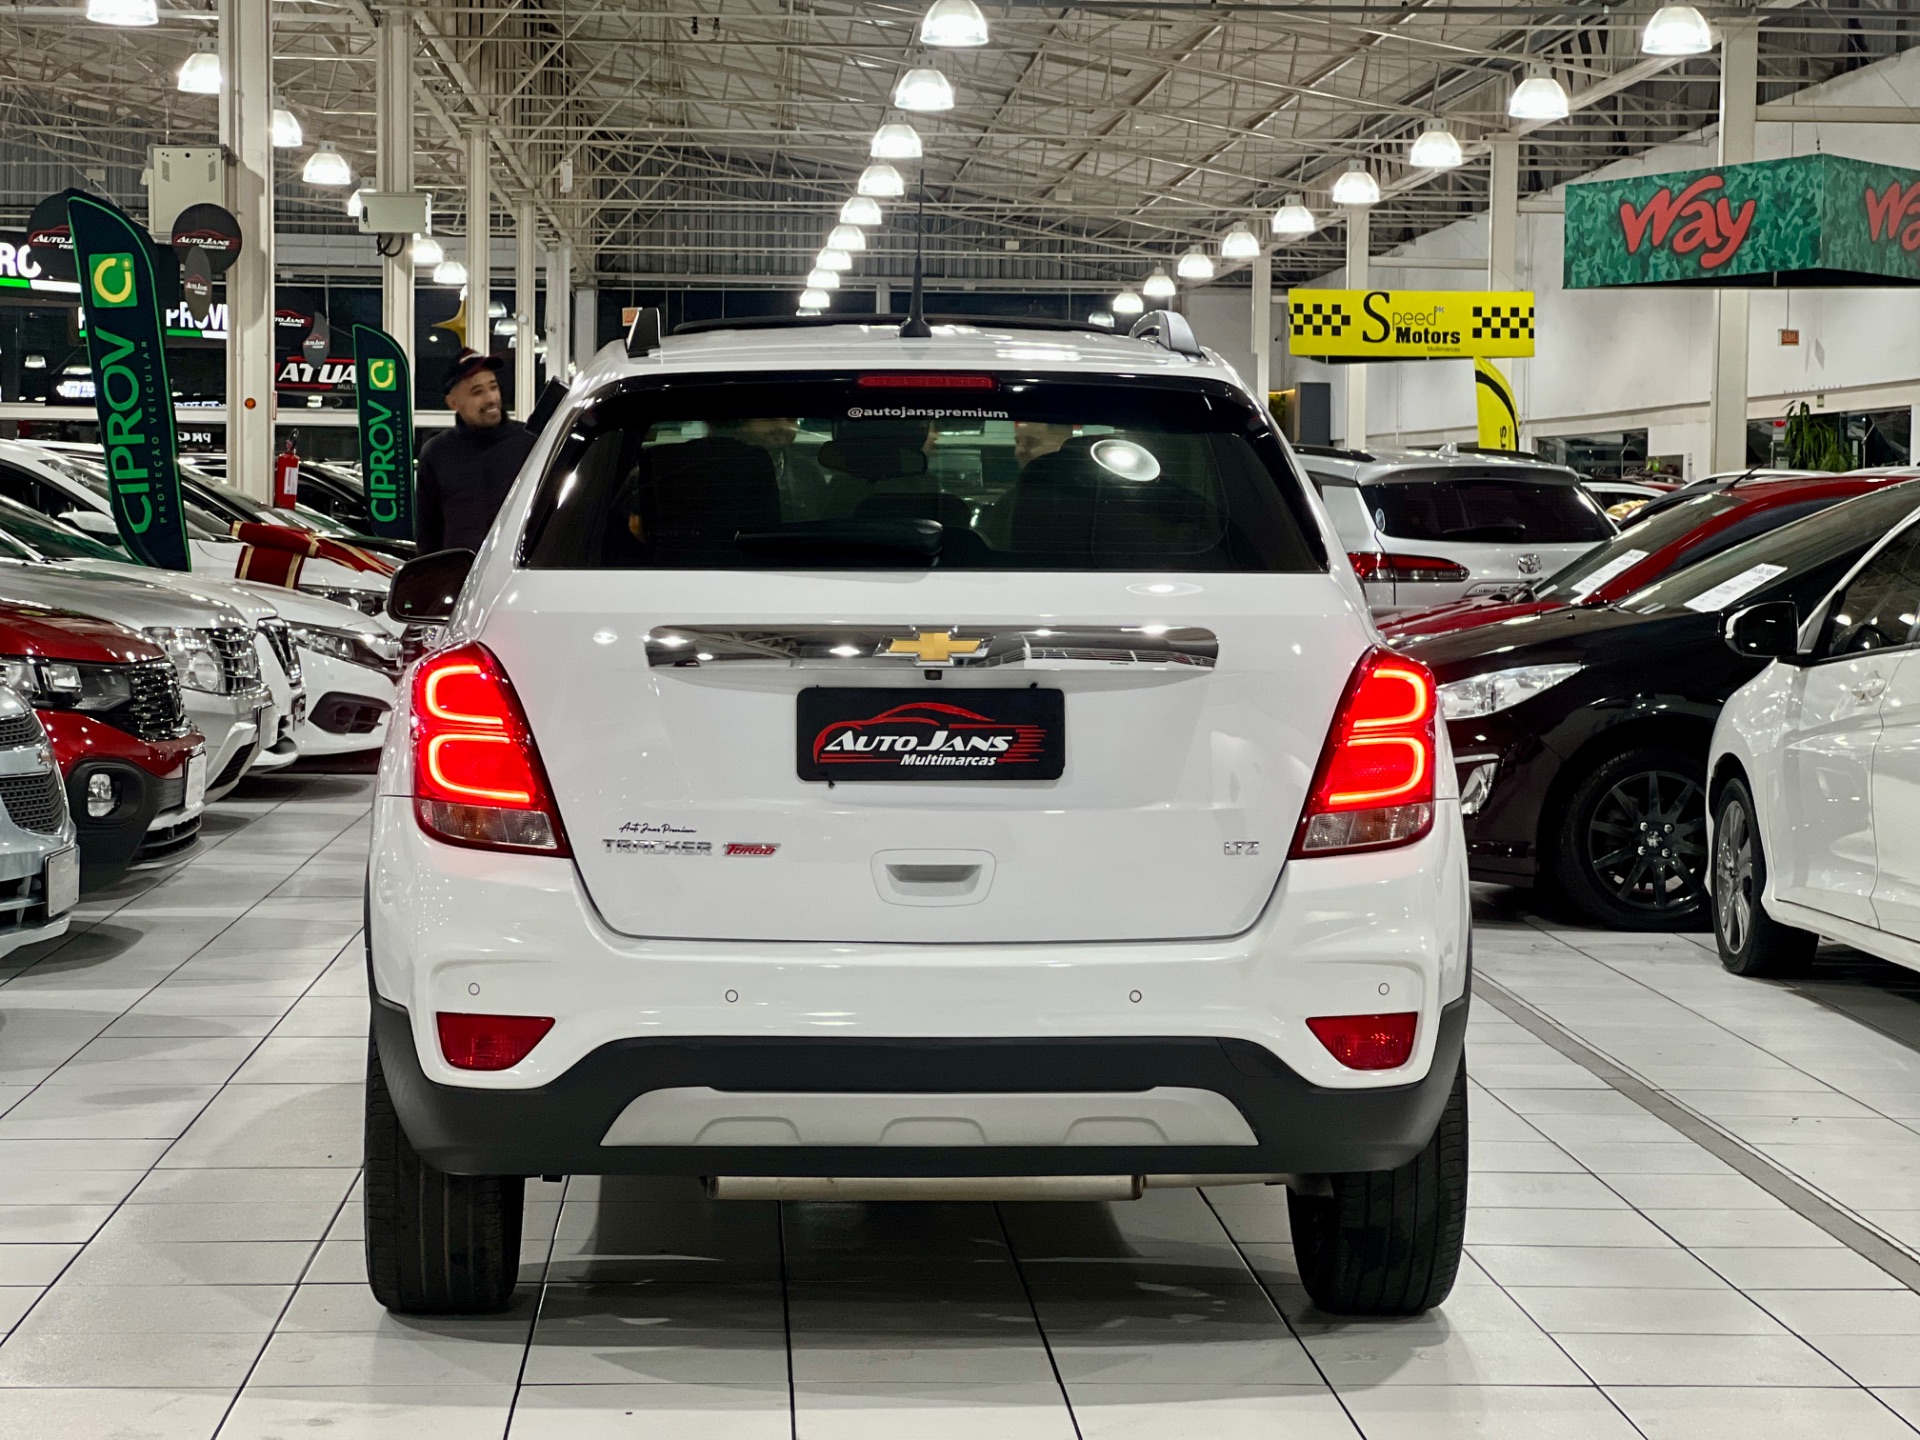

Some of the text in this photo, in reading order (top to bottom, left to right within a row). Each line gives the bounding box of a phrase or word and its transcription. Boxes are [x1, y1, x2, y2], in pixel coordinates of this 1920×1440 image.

[1362, 291, 1436, 343] Speed
[1395, 326, 1461, 344] Motors
[847, 406, 1009, 419] @autojanspremium
[94, 325, 153, 534] CIPROV
[141, 340, 168, 524] PROTEÇÃO VEICULAR
[367, 399, 398, 522] CIPROV
[824, 730, 1014, 751] AUTO JANS
[900, 753, 997, 767] Multimarcas
[602, 838, 780, 857] TRACKER TURBO
[1223, 841, 1260, 856] LTZ
